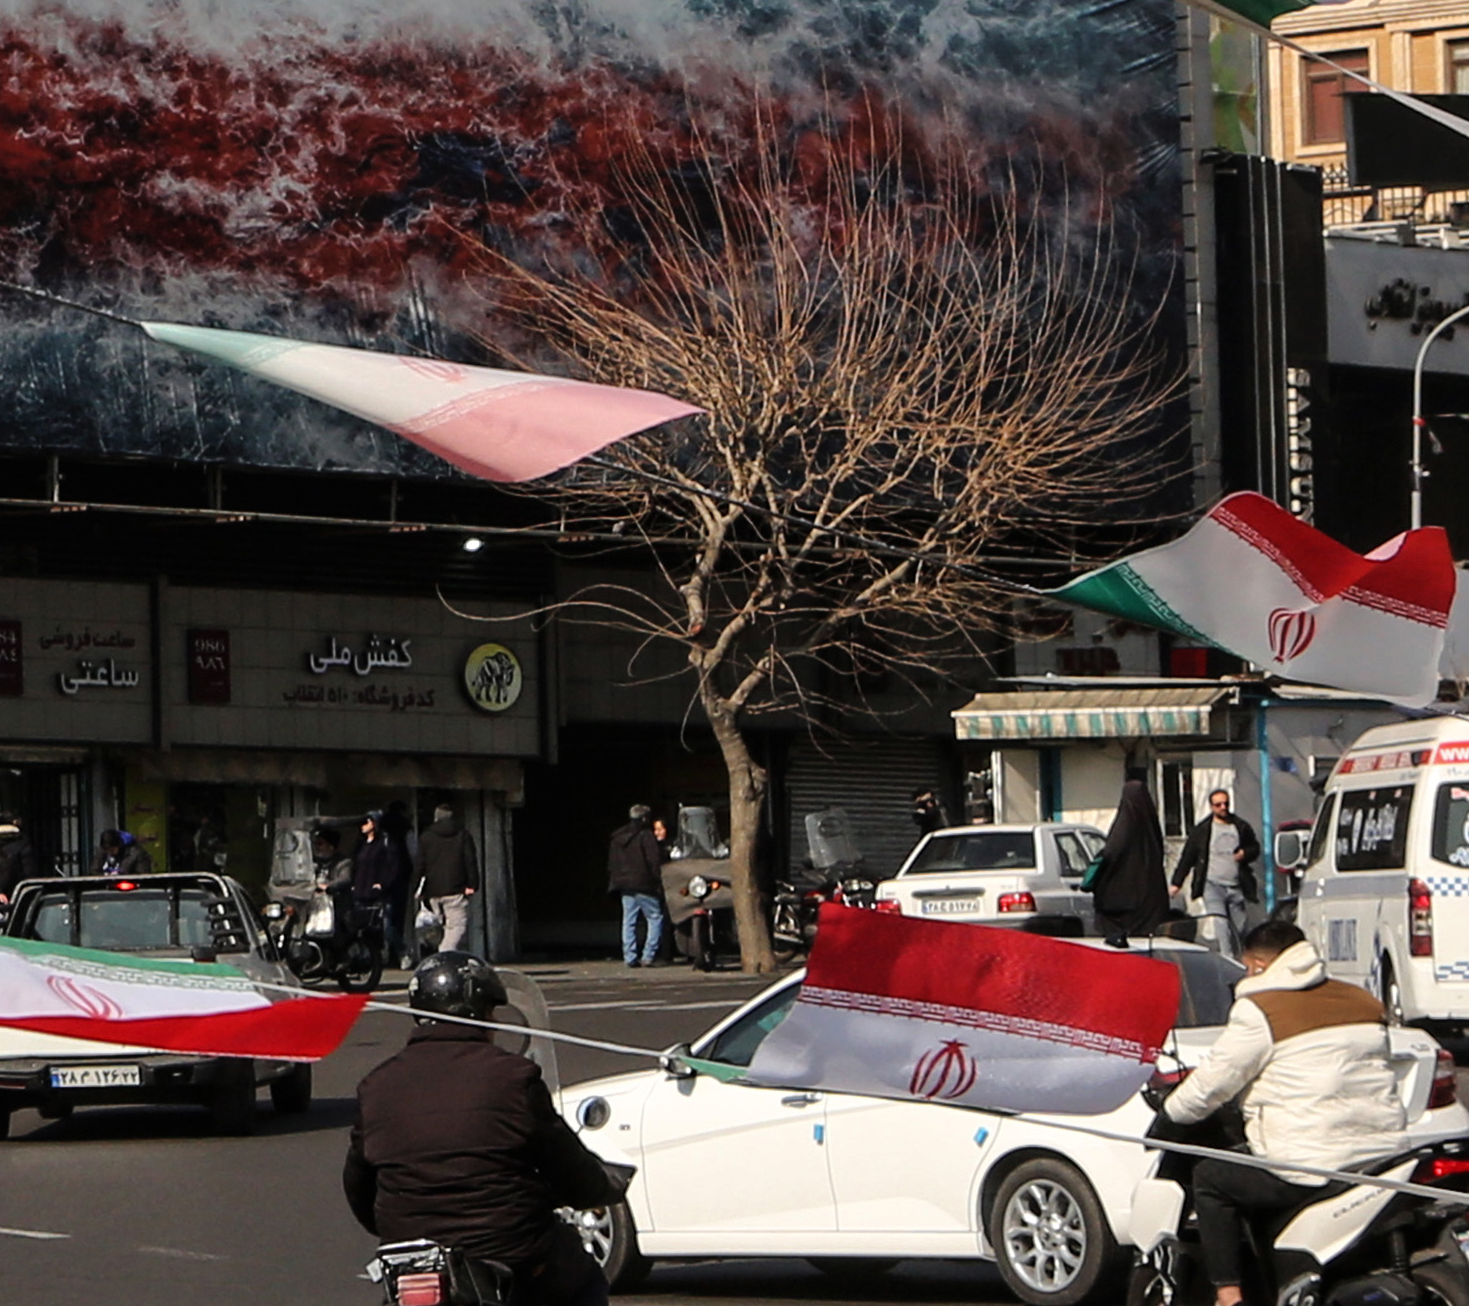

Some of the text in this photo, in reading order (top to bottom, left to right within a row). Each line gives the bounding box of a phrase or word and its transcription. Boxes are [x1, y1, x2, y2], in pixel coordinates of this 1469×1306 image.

[309, 634, 412, 675] کفش ملی
[61, 658, 139, 694] ساعتی
